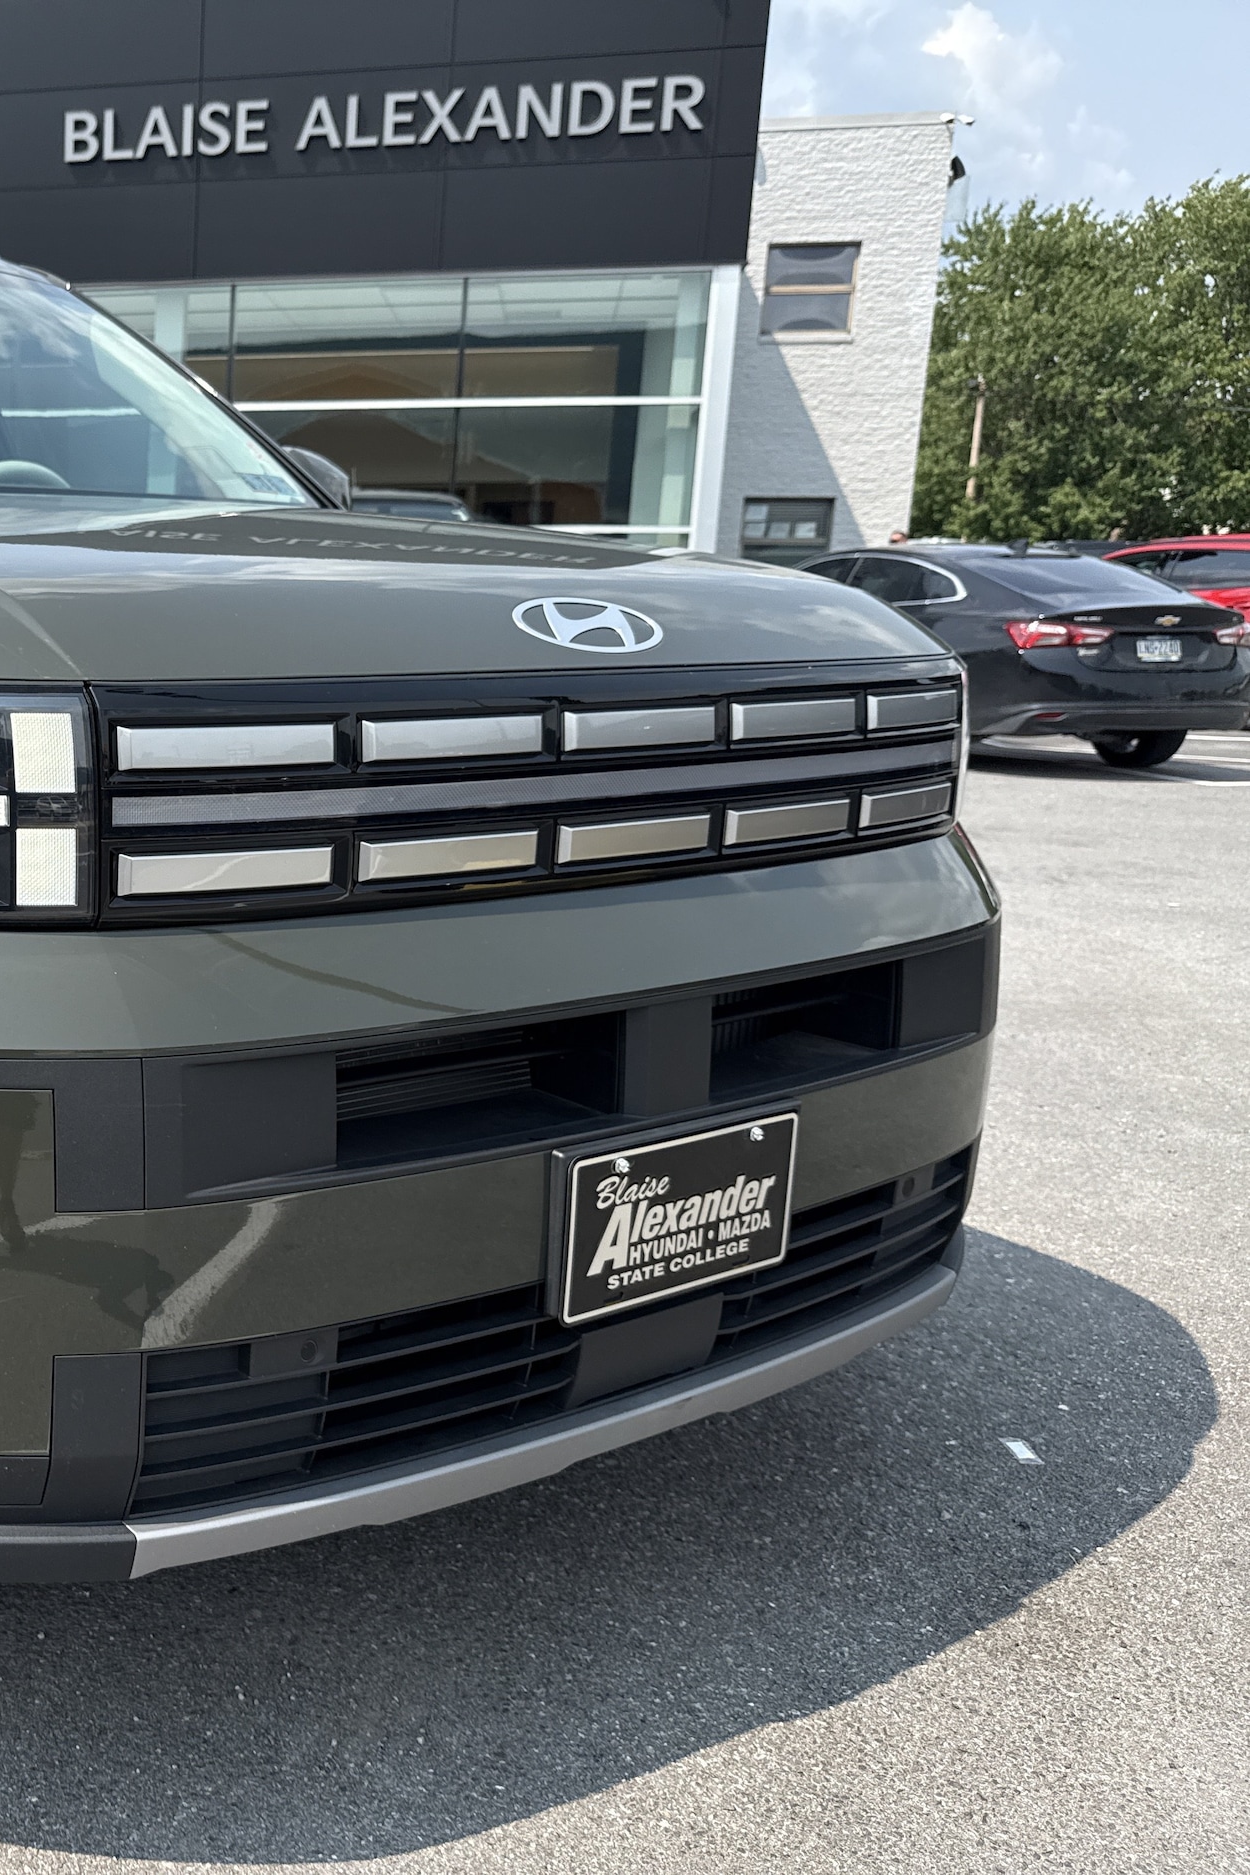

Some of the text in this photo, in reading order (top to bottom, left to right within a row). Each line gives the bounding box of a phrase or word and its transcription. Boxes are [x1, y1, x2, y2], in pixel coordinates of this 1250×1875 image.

[63, 74, 706, 164] BLAISE ALEXANDER
[595, 1175, 670, 1209] Blaise
[586, 1175, 776, 1277] Alexander
[629, 1210, 771, 1266] HYUNDAI MAZDA
[606, 1238, 750, 1290] STATE COLLEGE
